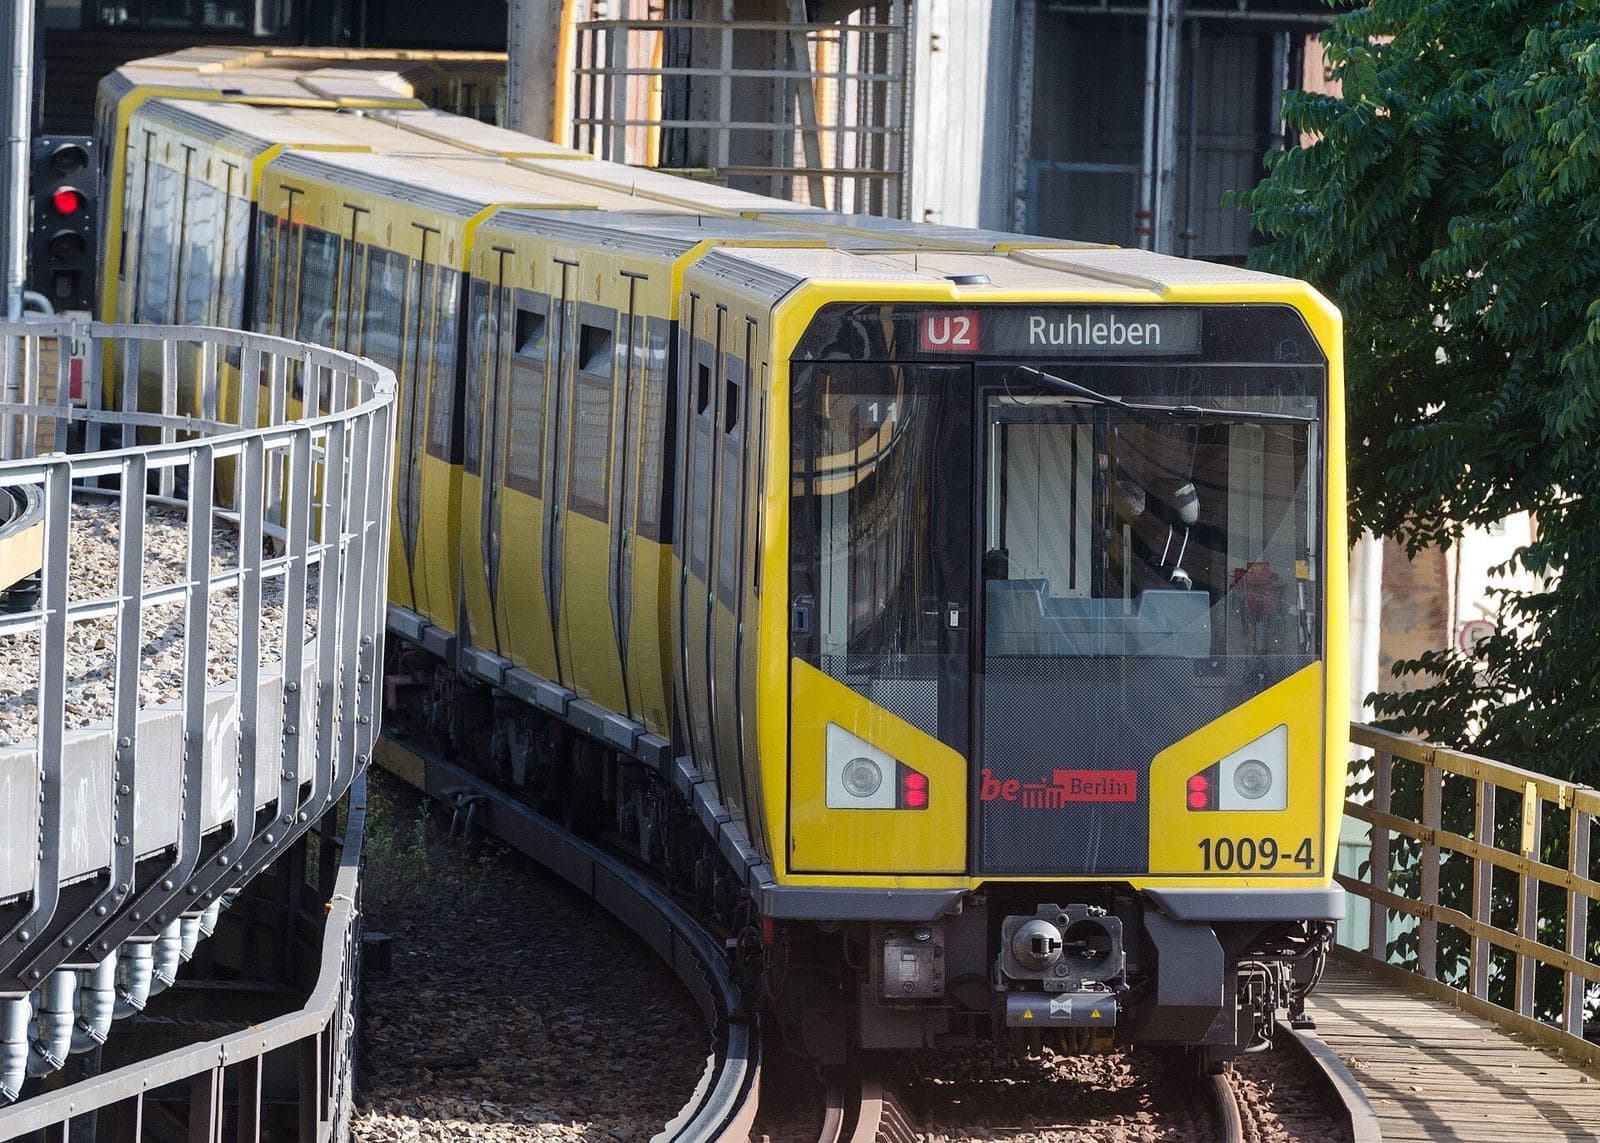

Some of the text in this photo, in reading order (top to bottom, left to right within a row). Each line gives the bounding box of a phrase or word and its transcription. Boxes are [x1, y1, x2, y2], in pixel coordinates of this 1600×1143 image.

[927, 314, 1161, 345] U2 Ruhleben
[980, 768, 1128, 802] be Berlin
[1198, 837, 1315, 871] 1009-4
